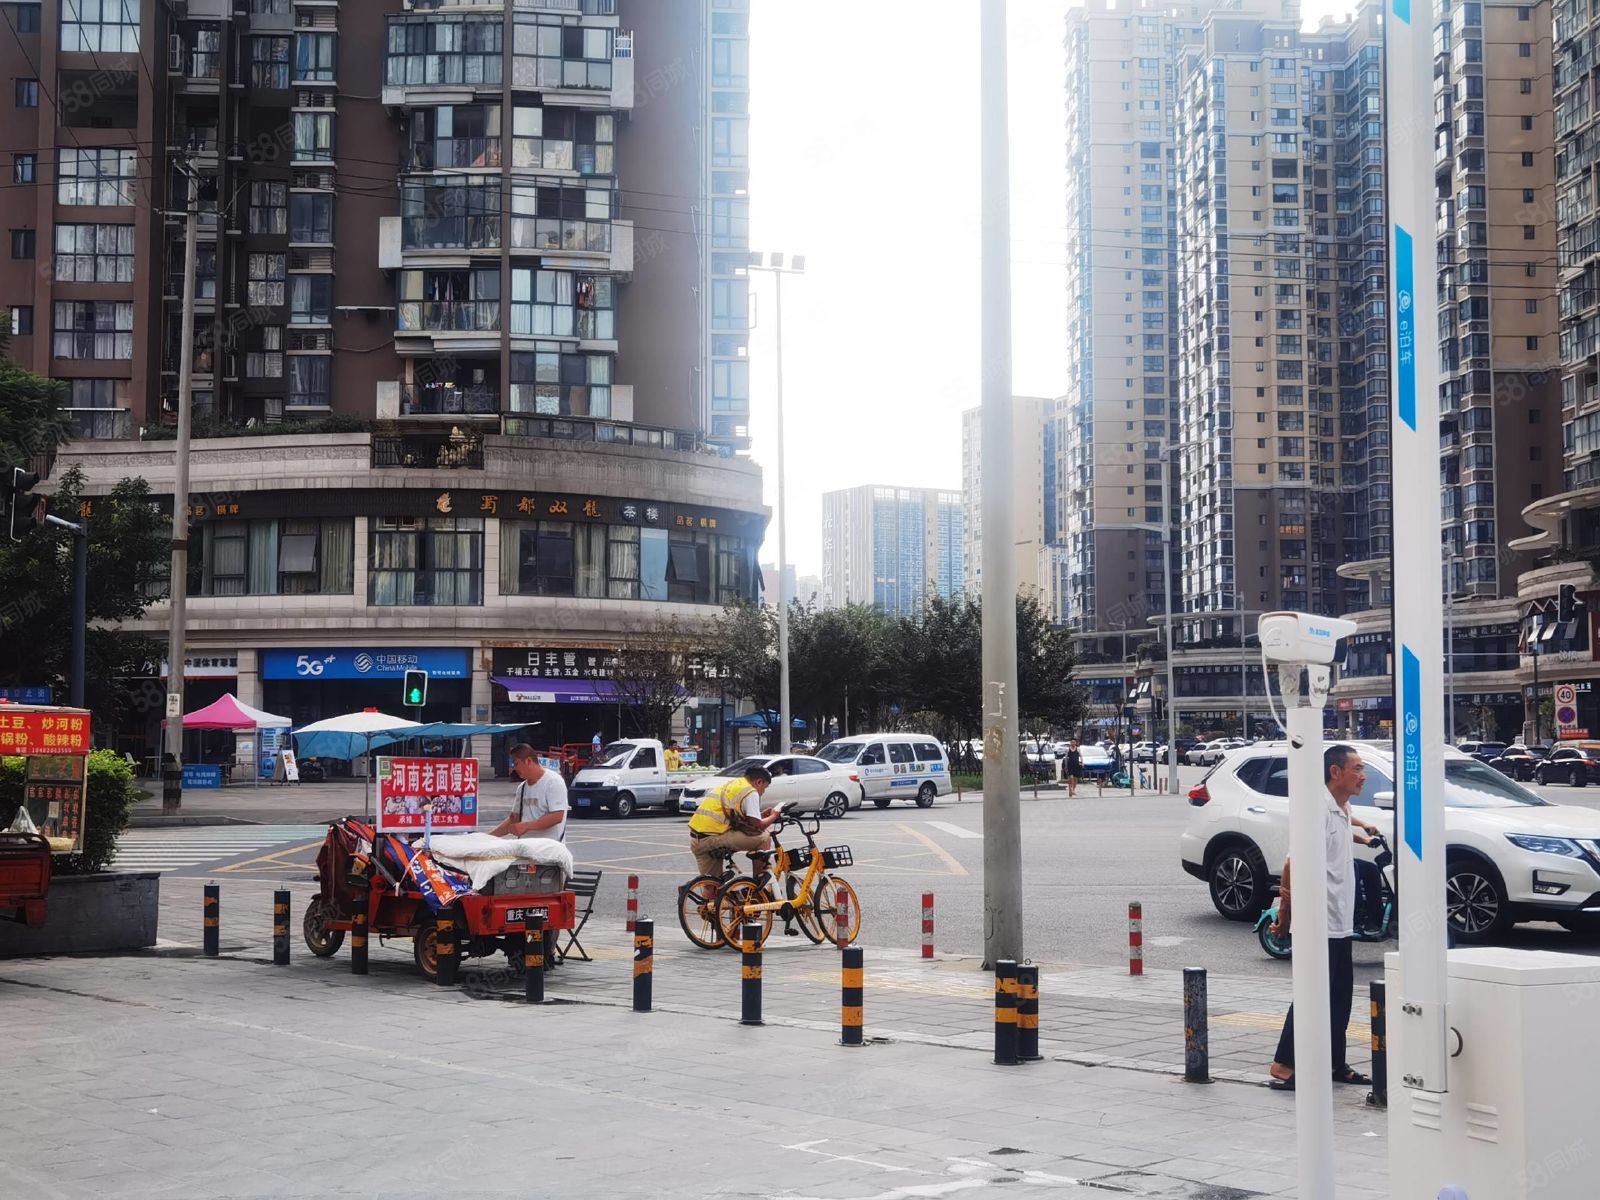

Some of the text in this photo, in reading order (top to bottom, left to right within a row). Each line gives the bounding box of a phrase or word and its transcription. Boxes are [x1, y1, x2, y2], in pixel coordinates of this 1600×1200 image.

[623, 505, 660, 521] 茶楼
[376, 654, 418, 665] 中国移动
[527, 651, 576, 667] 日丰管
[1559, 690, 1571, 700] 40
[41, 717, 83, 731] 炒河粉
[43, 733, 82, 747] 酸辣粉
[392, 762, 477, 793] 河南老面馒头
